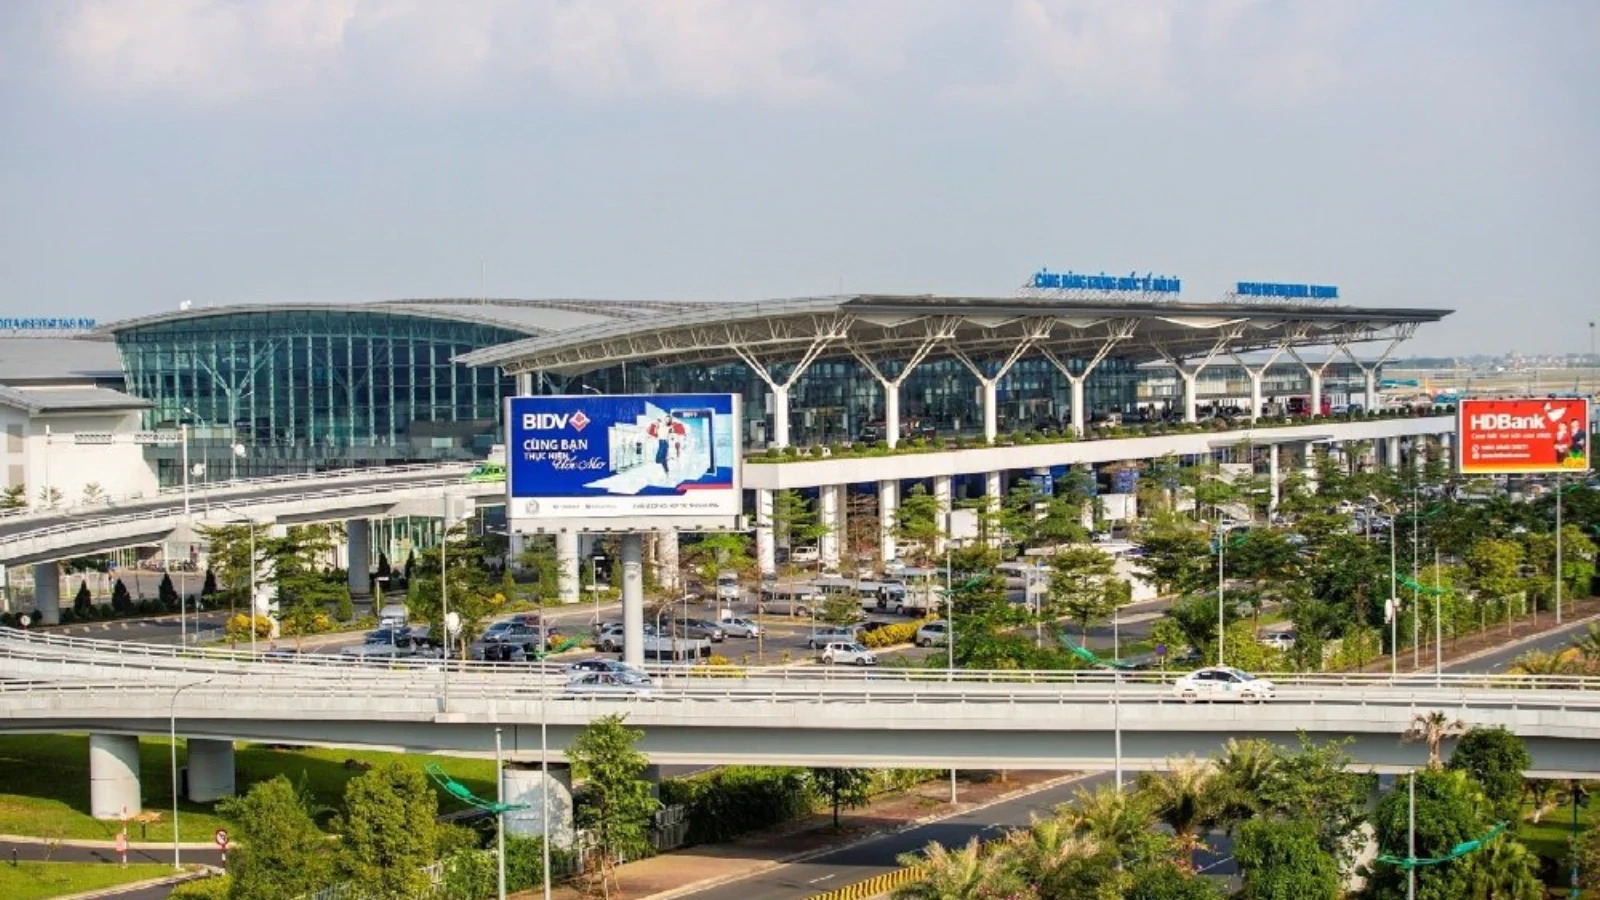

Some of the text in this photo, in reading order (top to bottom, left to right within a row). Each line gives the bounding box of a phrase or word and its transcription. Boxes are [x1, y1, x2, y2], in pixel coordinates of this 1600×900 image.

[522, 413, 569, 430] BIDV
[1470, 413, 1546, 430] HDBank
[523, 437, 588, 452] CÙNG BẠN
